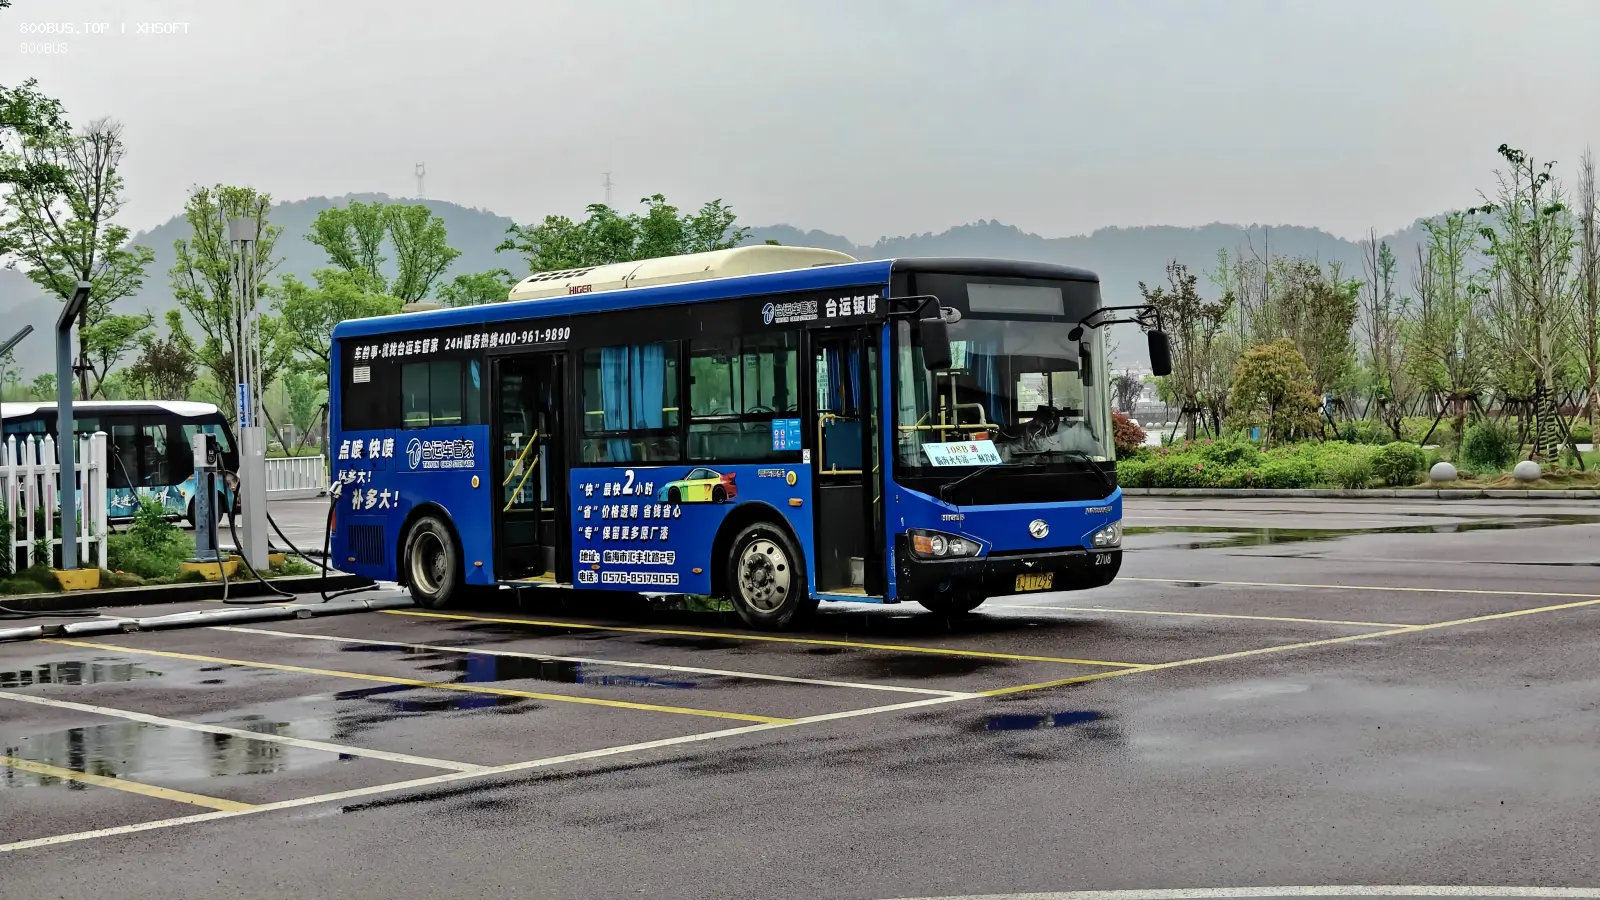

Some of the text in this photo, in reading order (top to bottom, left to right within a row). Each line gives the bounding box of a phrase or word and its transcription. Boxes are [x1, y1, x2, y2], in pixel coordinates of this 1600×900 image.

[569, 284, 592, 295] HIGER
[338, 438, 394, 460] 点喷 快喷
[422, 440, 475, 459] 台运车管家
[602, 525, 669, 540] 保留更多原厂漆
[601, 571, 679, 585] 0576-85179055
